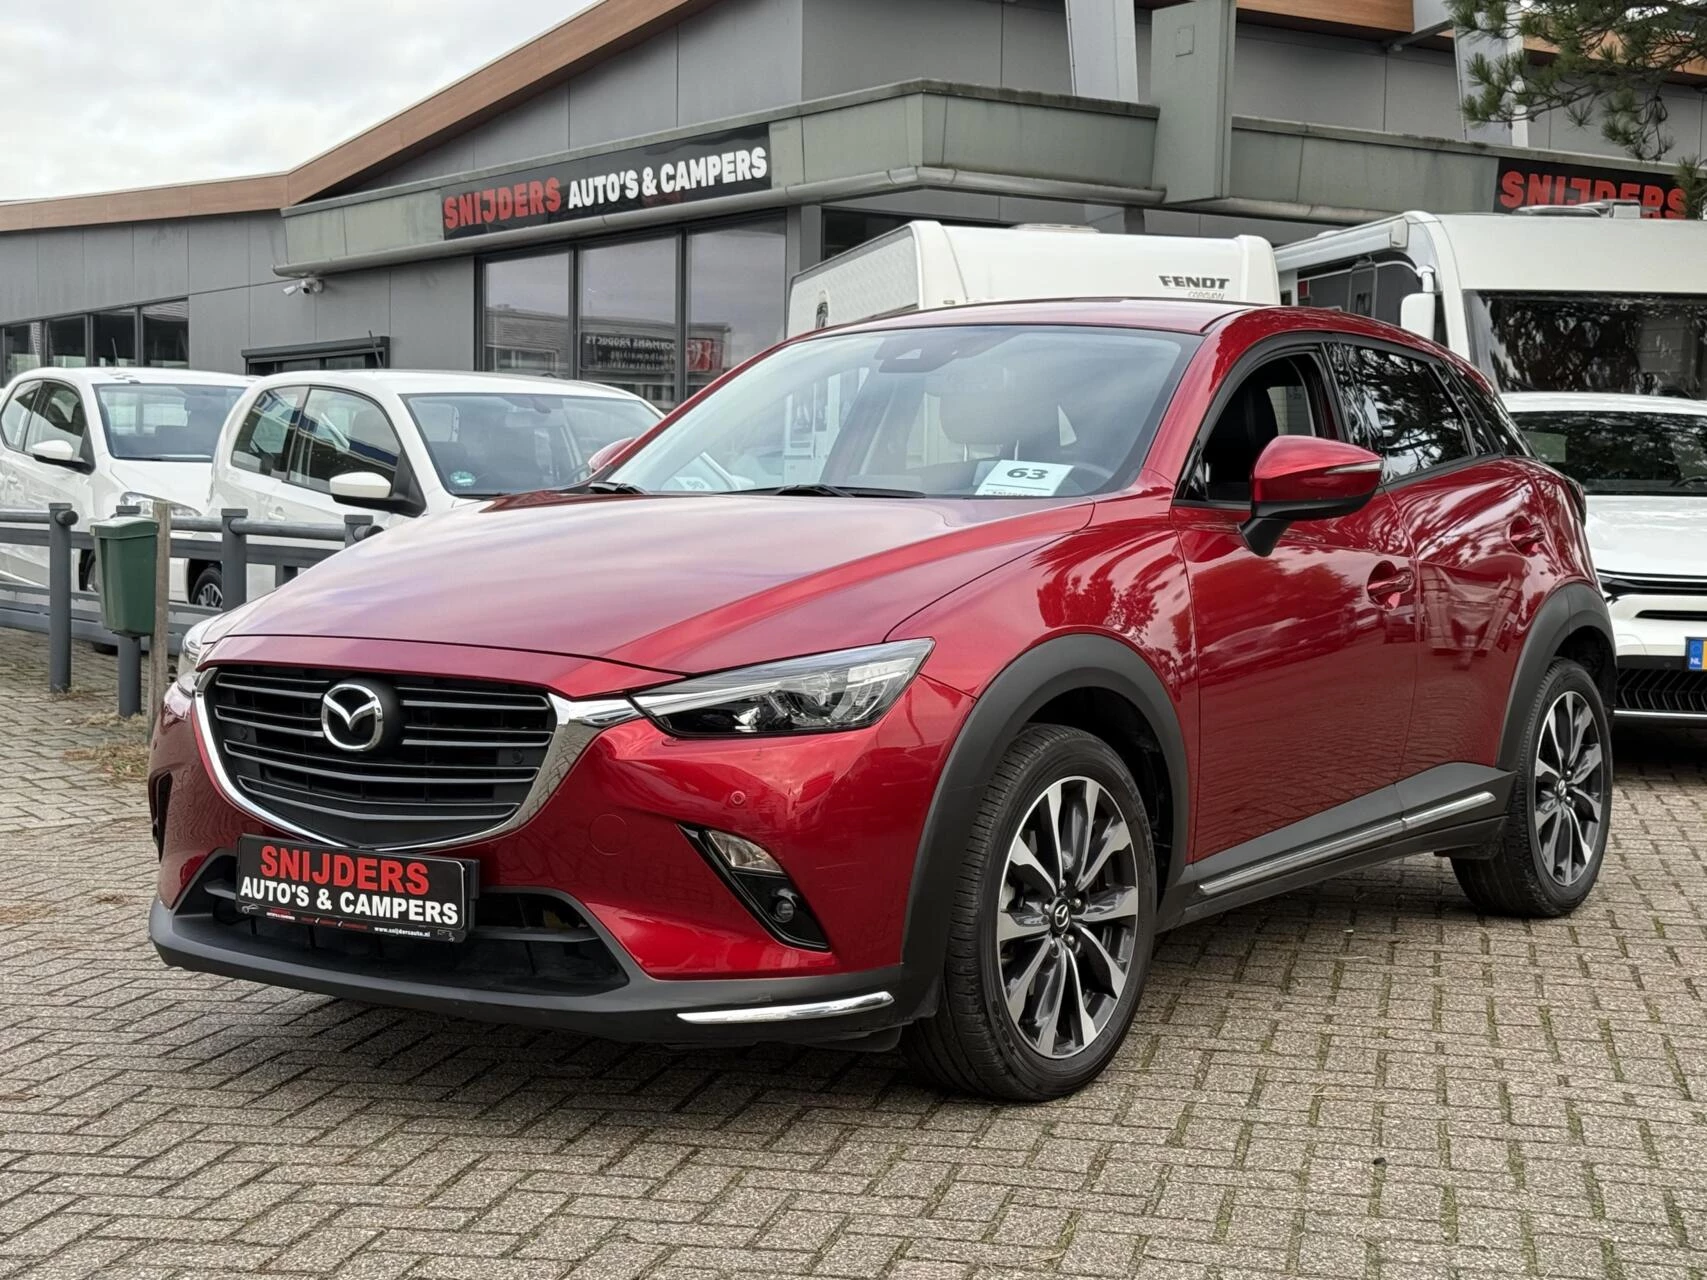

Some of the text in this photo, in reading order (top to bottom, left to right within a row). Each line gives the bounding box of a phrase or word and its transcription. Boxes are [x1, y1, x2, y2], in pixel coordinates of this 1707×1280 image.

[443, 147, 768, 230] SNIJDERS AUTO'S & CAMPERS
[1158, 275, 1230, 289] FENDT
[1006, 467, 1049, 480] 63
[1690, 657, 1701, 665] NL
[260, 846, 430, 896] SNIJDERS
[240, 876, 310, 907] AUTO'S
[316, 888, 333, 911] &
[339, 891, 458, 926] CAMPERS
